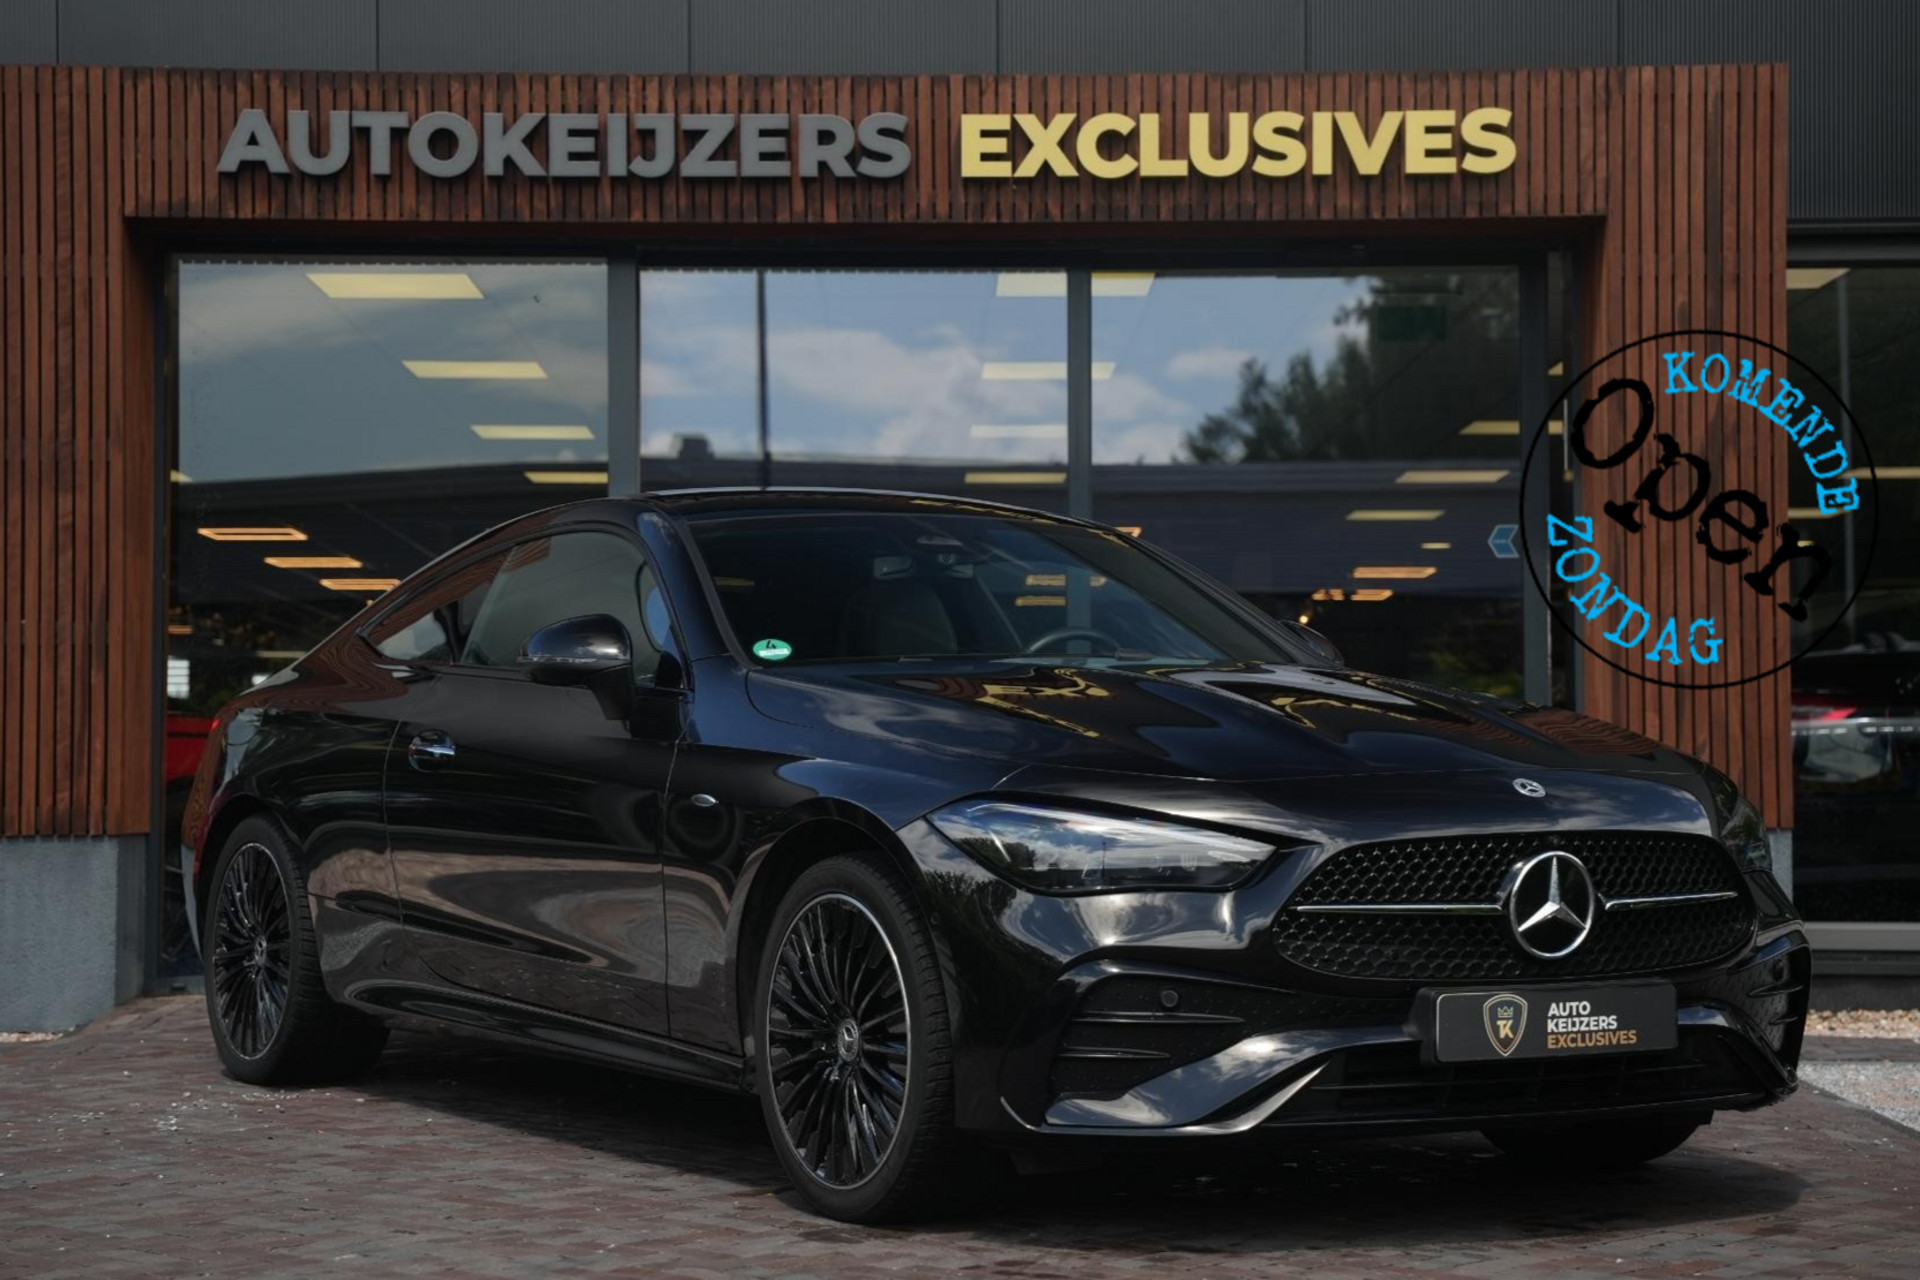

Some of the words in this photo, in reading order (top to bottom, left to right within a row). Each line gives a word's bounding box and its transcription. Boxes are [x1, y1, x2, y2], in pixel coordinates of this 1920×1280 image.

[217, 108, 912, 179] AUTOKEIJZERS
[960, 107, 1517, 179] EXCLUSIVES
[1548, 1001, 1591, 1016] AUTO
[1547, 1015, 1618, 1033] KEIJZERS
[1547, 1030, 1637, 1049] EXCLUSIVES
